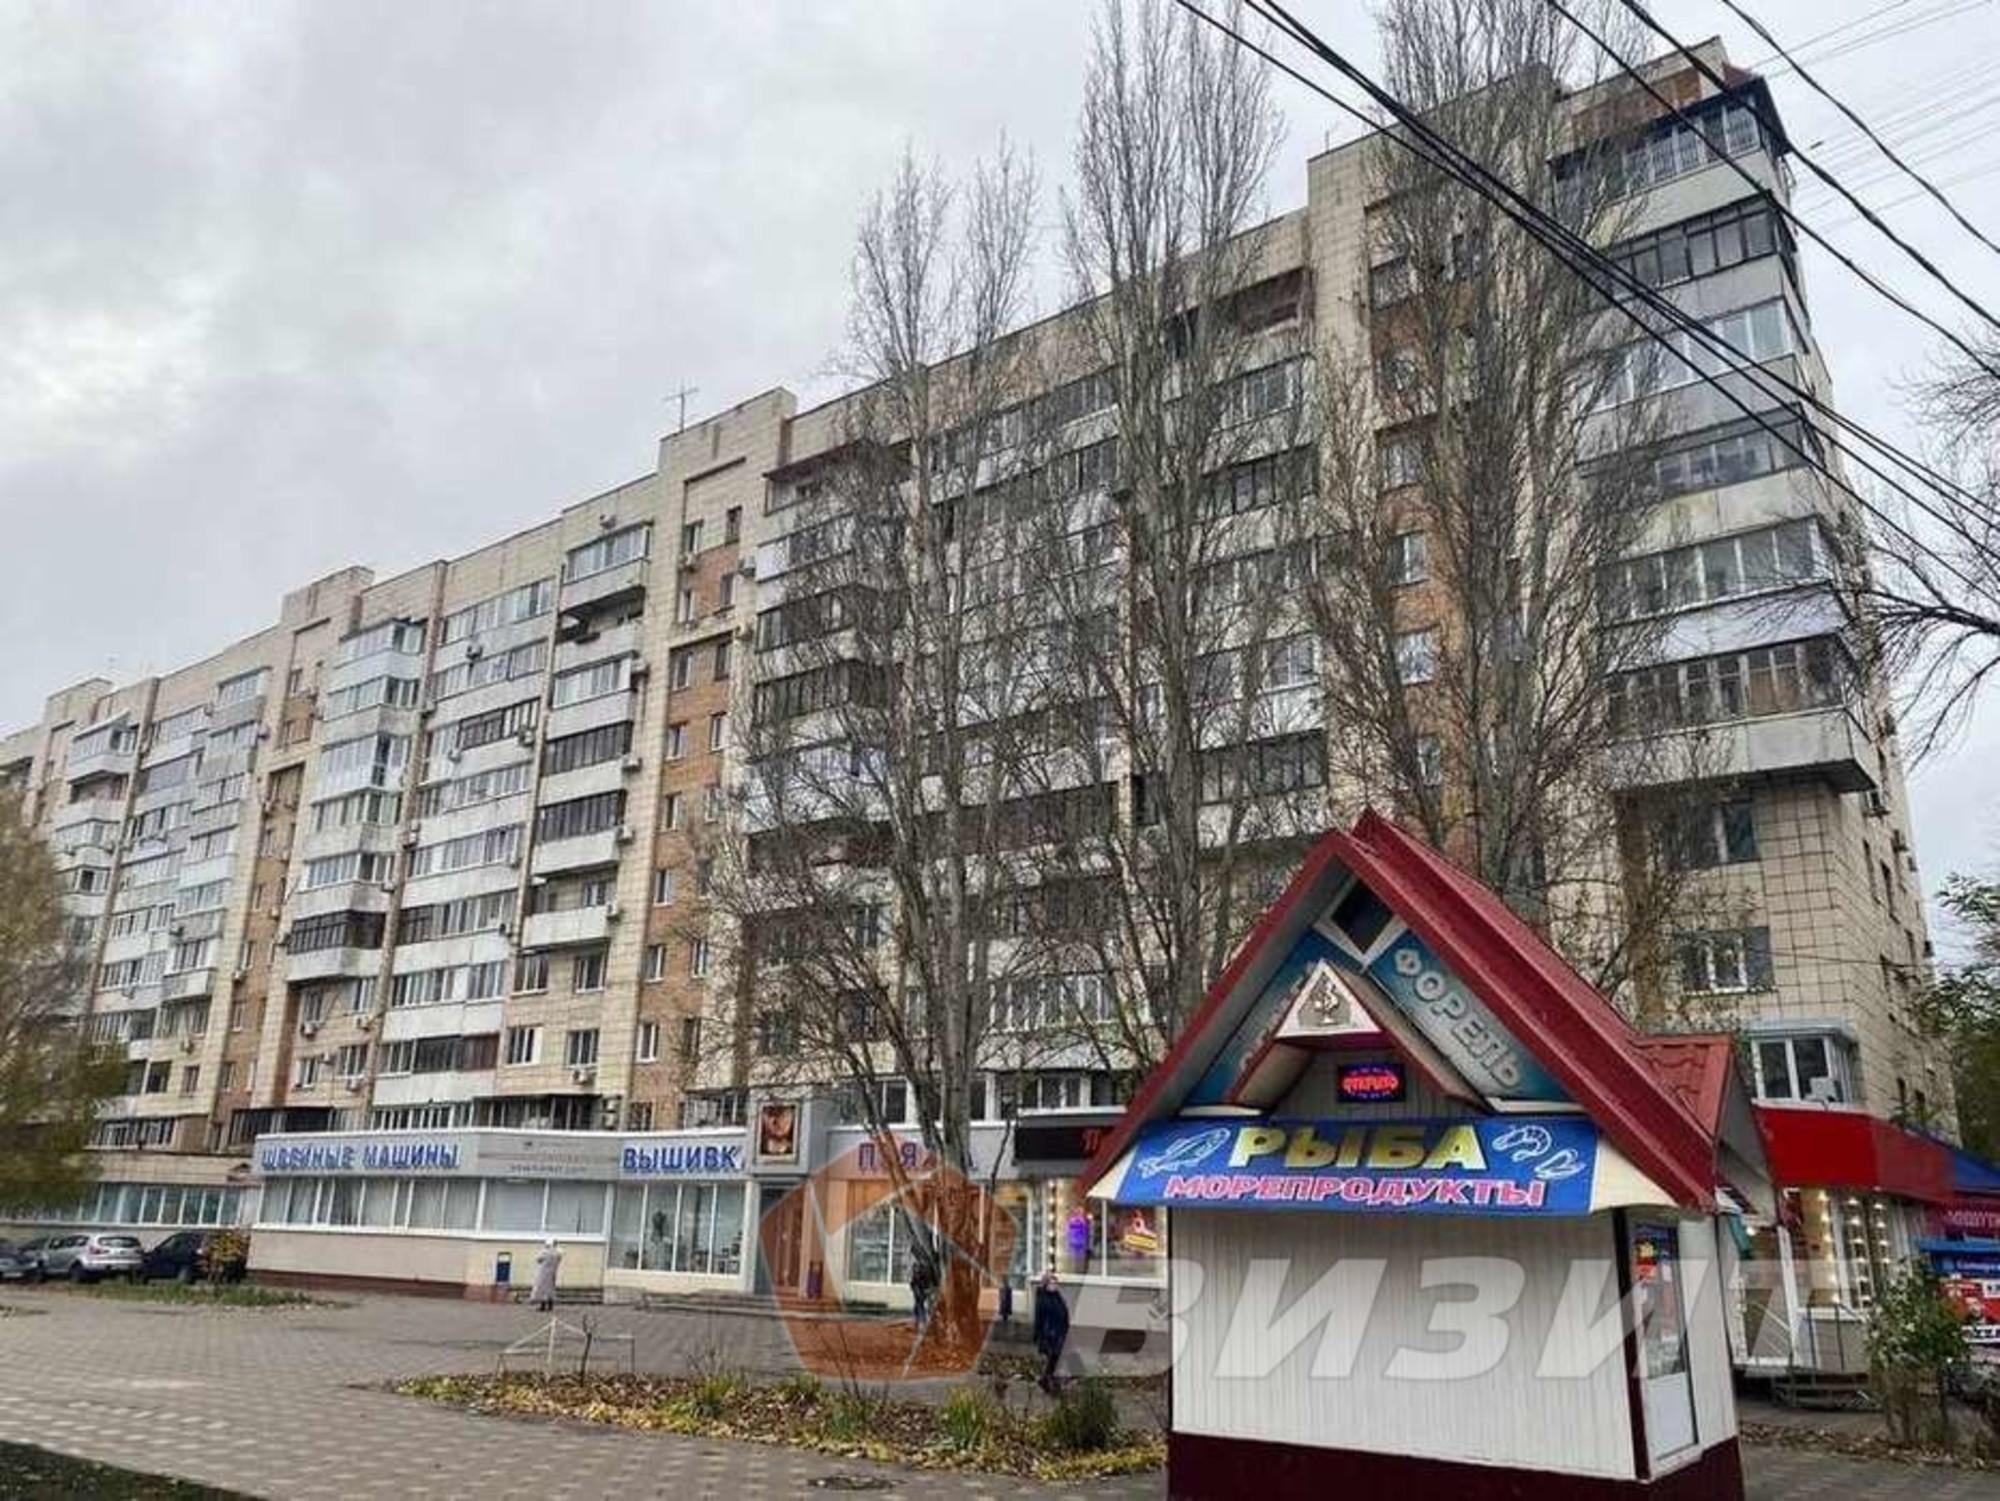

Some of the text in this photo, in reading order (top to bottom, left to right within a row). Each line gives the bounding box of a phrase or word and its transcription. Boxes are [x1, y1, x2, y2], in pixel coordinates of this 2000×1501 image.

[1394, 948, 1521, 1087] ФОРЕЛЬ
[362, 1143, 460, 1169] МАШИНЫ
[1228, 1124, 1488, 1170] РЫБА
[1164, 1174, 1546, 1207] МОРЕПРОДУКТЫ
